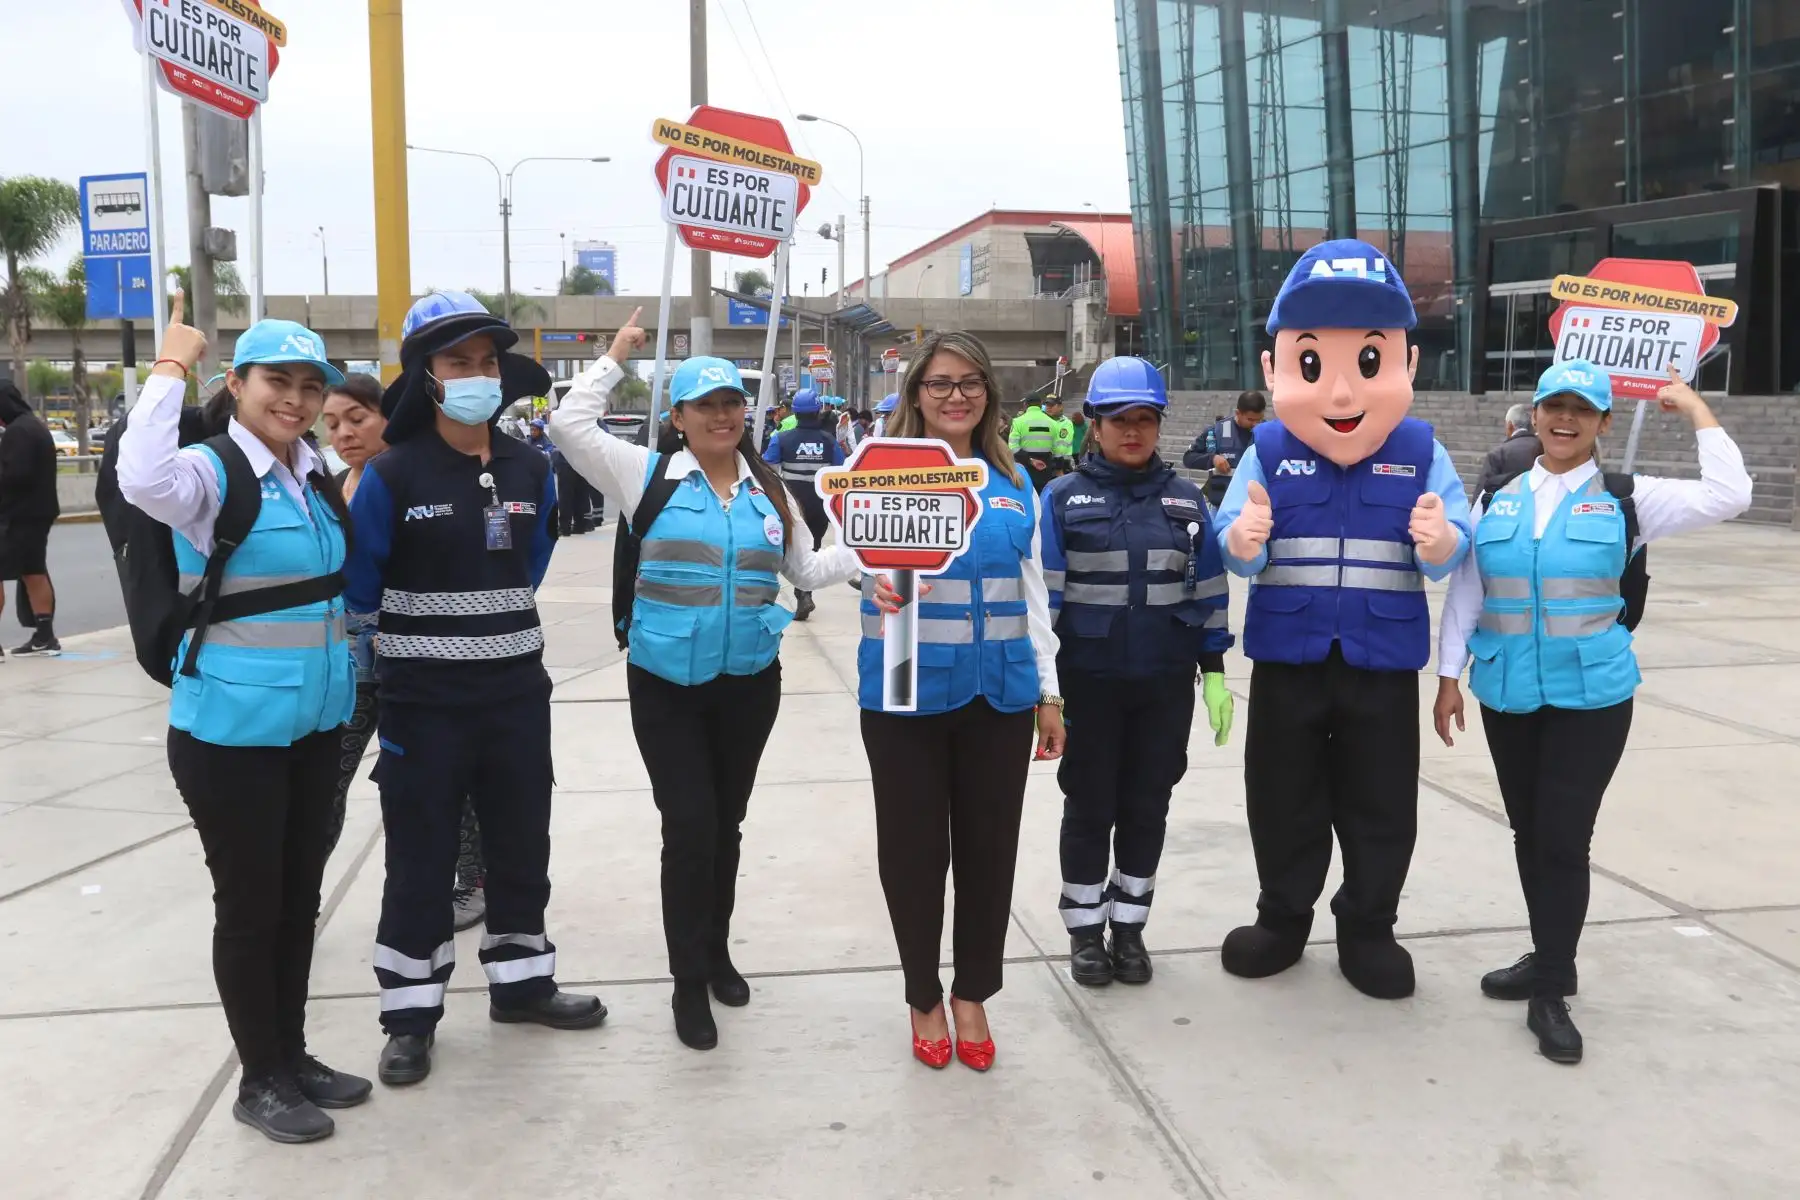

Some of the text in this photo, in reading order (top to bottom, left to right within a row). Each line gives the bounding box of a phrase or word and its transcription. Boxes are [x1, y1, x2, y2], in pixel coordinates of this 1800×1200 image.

[181, 0, 242, 44] ES POR
[150, 8, 260, 93] CUIDARTE
[659, 124, 816, 180] NO ES POR MOLESTARTE
[707, 167, 770, 193] ES POR
[672, 182, 787, 232] CUIDARTE
[90, 231, 148, 251] PARADERO
[1558, 280, 1727, 318] NO ES POR MOLESTARTE
[1601, 316, 1670, 336] ES POR
[1561, 332, 1688, 373] CUIDARTE
[796, 442, 824, 455] ATU
[1275, 459, 1316, 475] ATU
[828, 471, 978, 489] NO ES POR MOLESTARTE
[881, 496, 940, 512] ES POR
[1066, 495, 1091, 505] ATU
[405, 505, 434, 521] ATU
[851, 513, 957, 545] CUIDARTE
